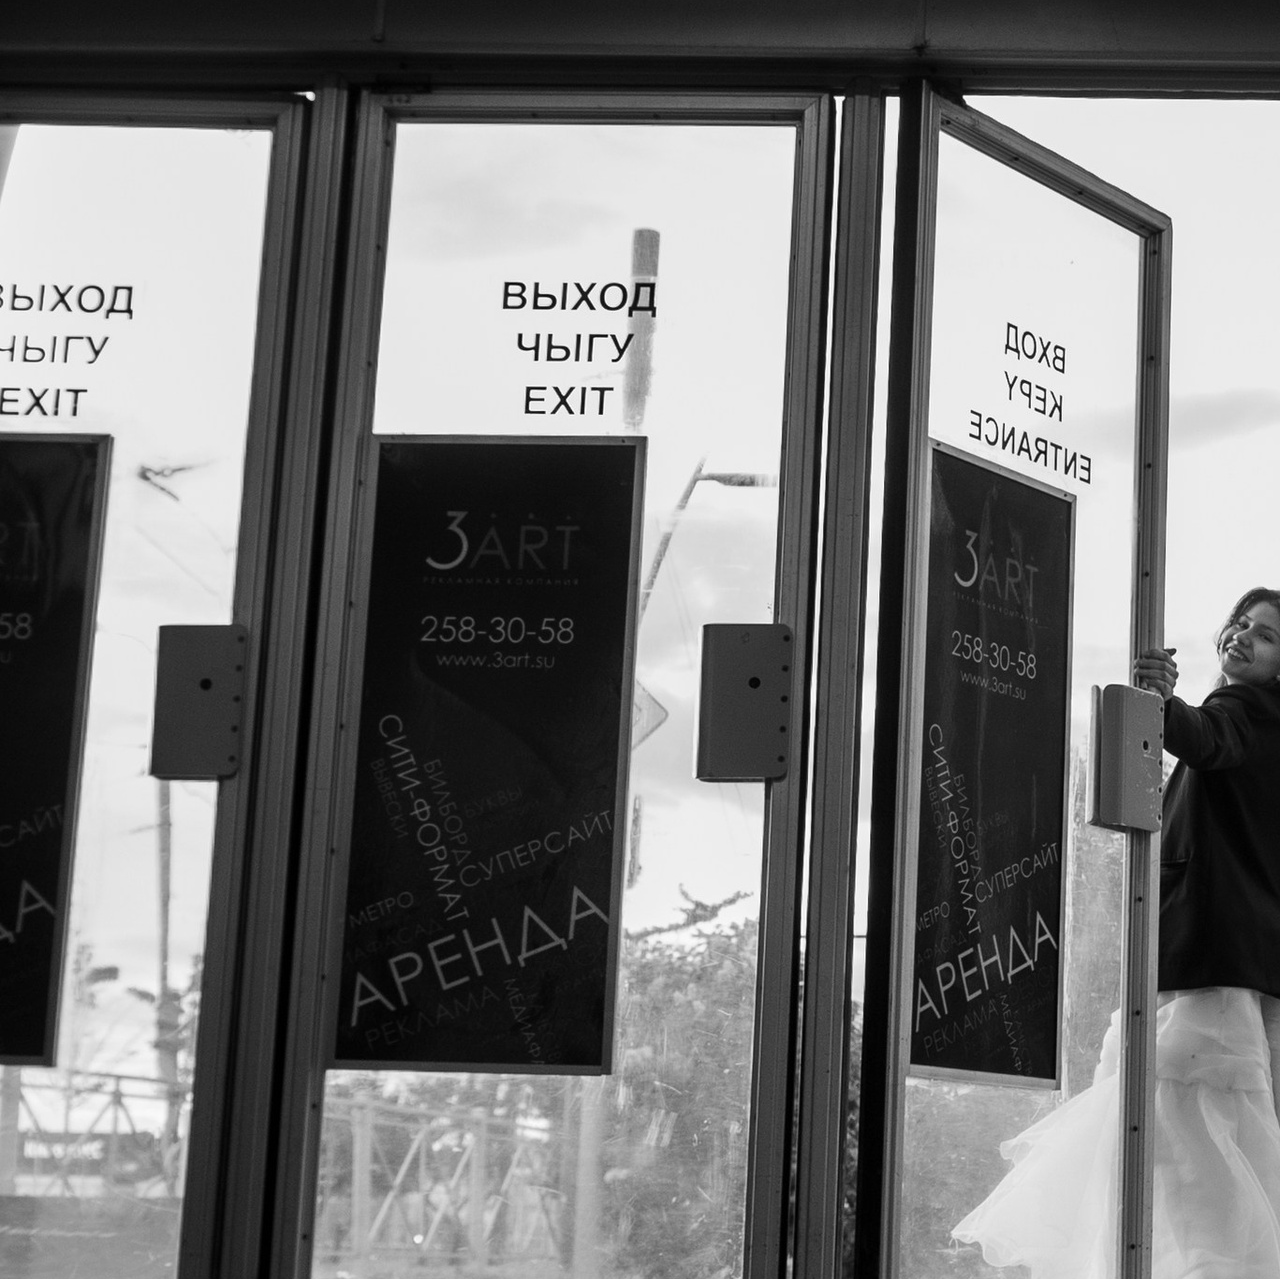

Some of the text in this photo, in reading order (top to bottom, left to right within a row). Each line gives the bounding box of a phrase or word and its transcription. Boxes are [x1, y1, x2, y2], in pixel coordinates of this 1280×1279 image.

[0, 283, 133, 320] ЫХОД
[502, 281, 657, 318] ВЫХОД
[517, 333, 635, 363] ЧЫГУ
[0, 387, 88, 417] EXIT
[524, 386, 614, 416] EXIT
[425, 510, 581, 571] 3ART
[953, 529, 1039, 608] 3ART
[419, 614, 576, 645] 258-30-58
[950, 629, 1038, 680] 258-30-58
[435, 650, 556, 670] www.3art.su
[960, 670, 1027, 700] www.3art.su
[378, 713, 470, 922] СИТИ-ФОРМАТ
[928, 723, 982, 935] СИТИ-ФОРМАТ
[459, 809, 614, 887] СУПЕРСАЙТ
[974, 842, 1059, 903] СУПЕРСАЙТ
[348, 891, 414, 928] МЕТРО
[350, 884, 609, 1028] АРЕНДА
[914, 910, 1058, 1033] АРЕНДА
[364, 985, 501, 1052] РЕКЛАМА
[503, 978, 545, 1064] МЕДИАФ
[923, 998, 999, 1058] РЕКЛАМА
